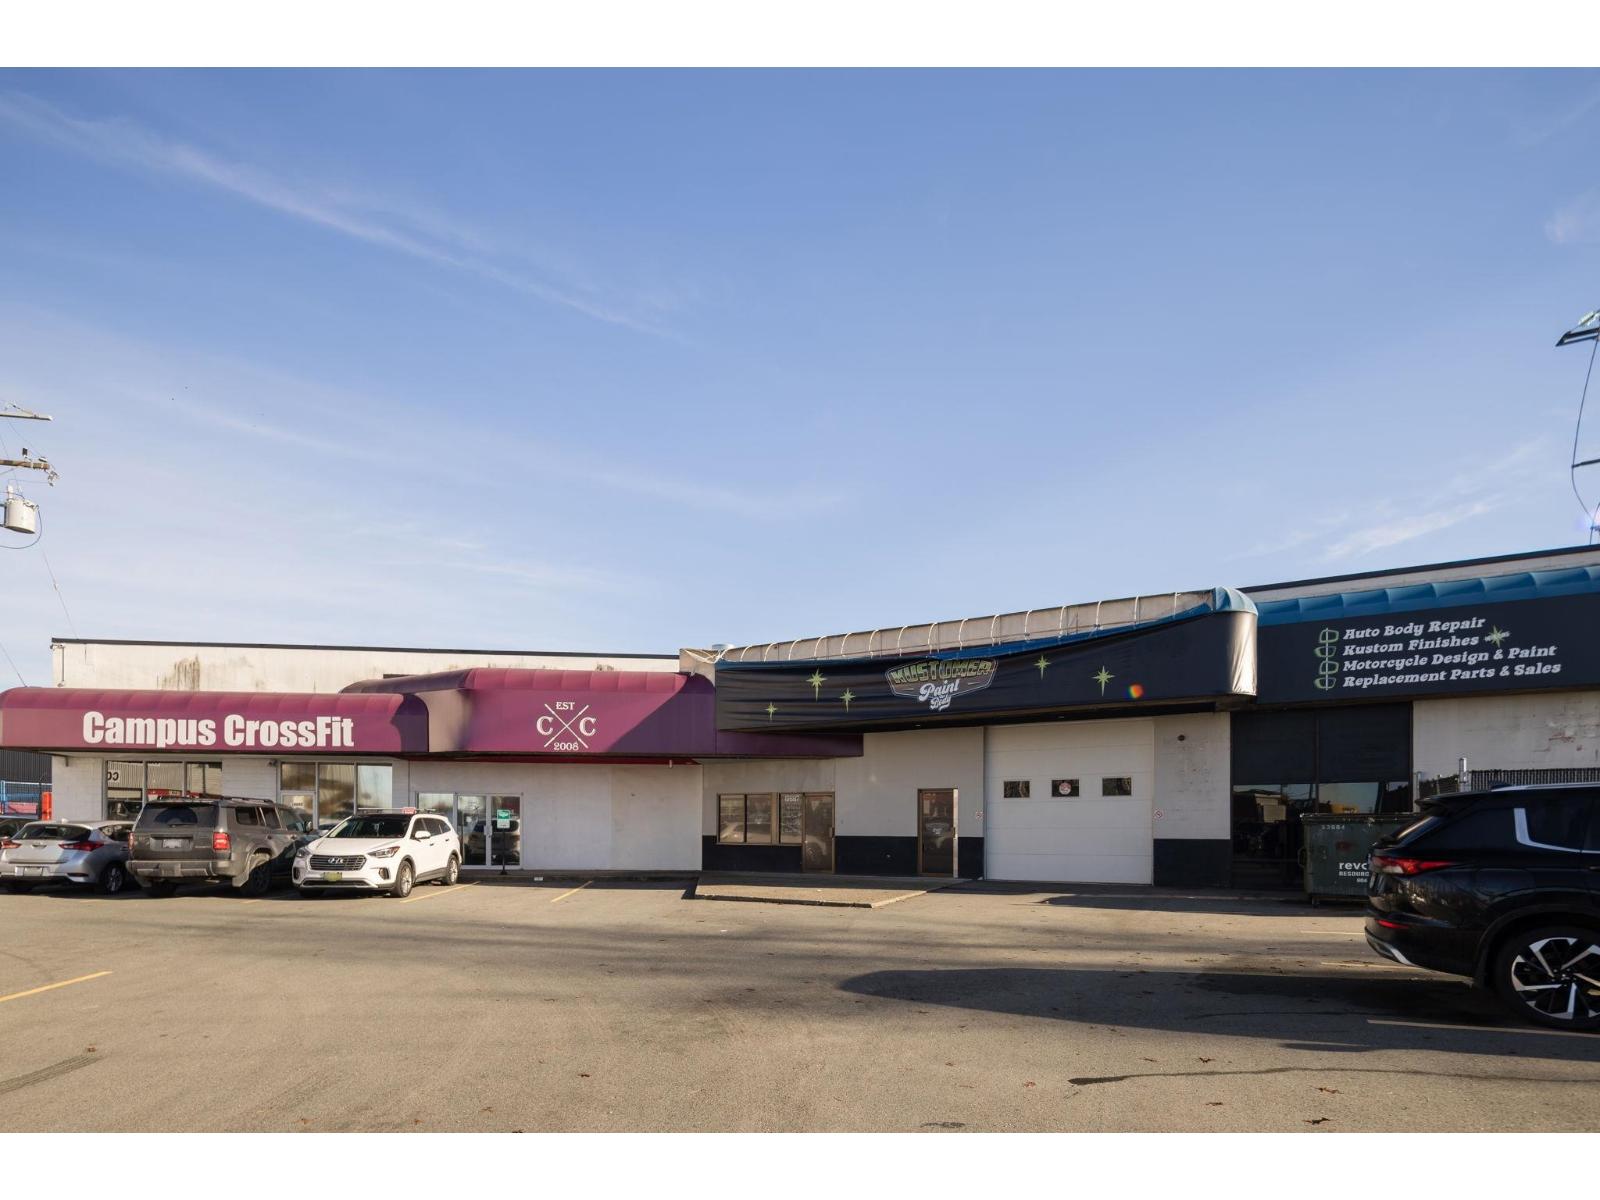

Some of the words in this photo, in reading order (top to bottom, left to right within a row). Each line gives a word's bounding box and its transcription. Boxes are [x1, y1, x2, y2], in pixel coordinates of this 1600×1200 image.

[1342, 628, 1380, 640] Auto
[1383, 622, 1424, 636] Body
[1427, 617, 1486, 633] Repair
[1342, 643, 1404, 656] Kustom
[1408, 637, 1479, 651] Finishes
[1342, 655, 1428, 671] Motorcycle
[1431, 651, 1489, 665] Design
[1493, 649, 1504, 660] &
[1507, 645, 1558, 659] Paint
[891, 660, 992, 684] KUSTOMER
[1342, 670, 1447, 689] Replacement
[1449, 667, 1496, 681] Parts
[1499, 665, 1510, 677] &
[1513, 662, 1562, 676] Sales
[918, 679, 960, 702] Paint
[555, 701, 575, 711] EST
[83, 711, 216, 748] Campus
[224, 714, 354, 747] CrossFit
[553, 742, 579, 751] 2008
